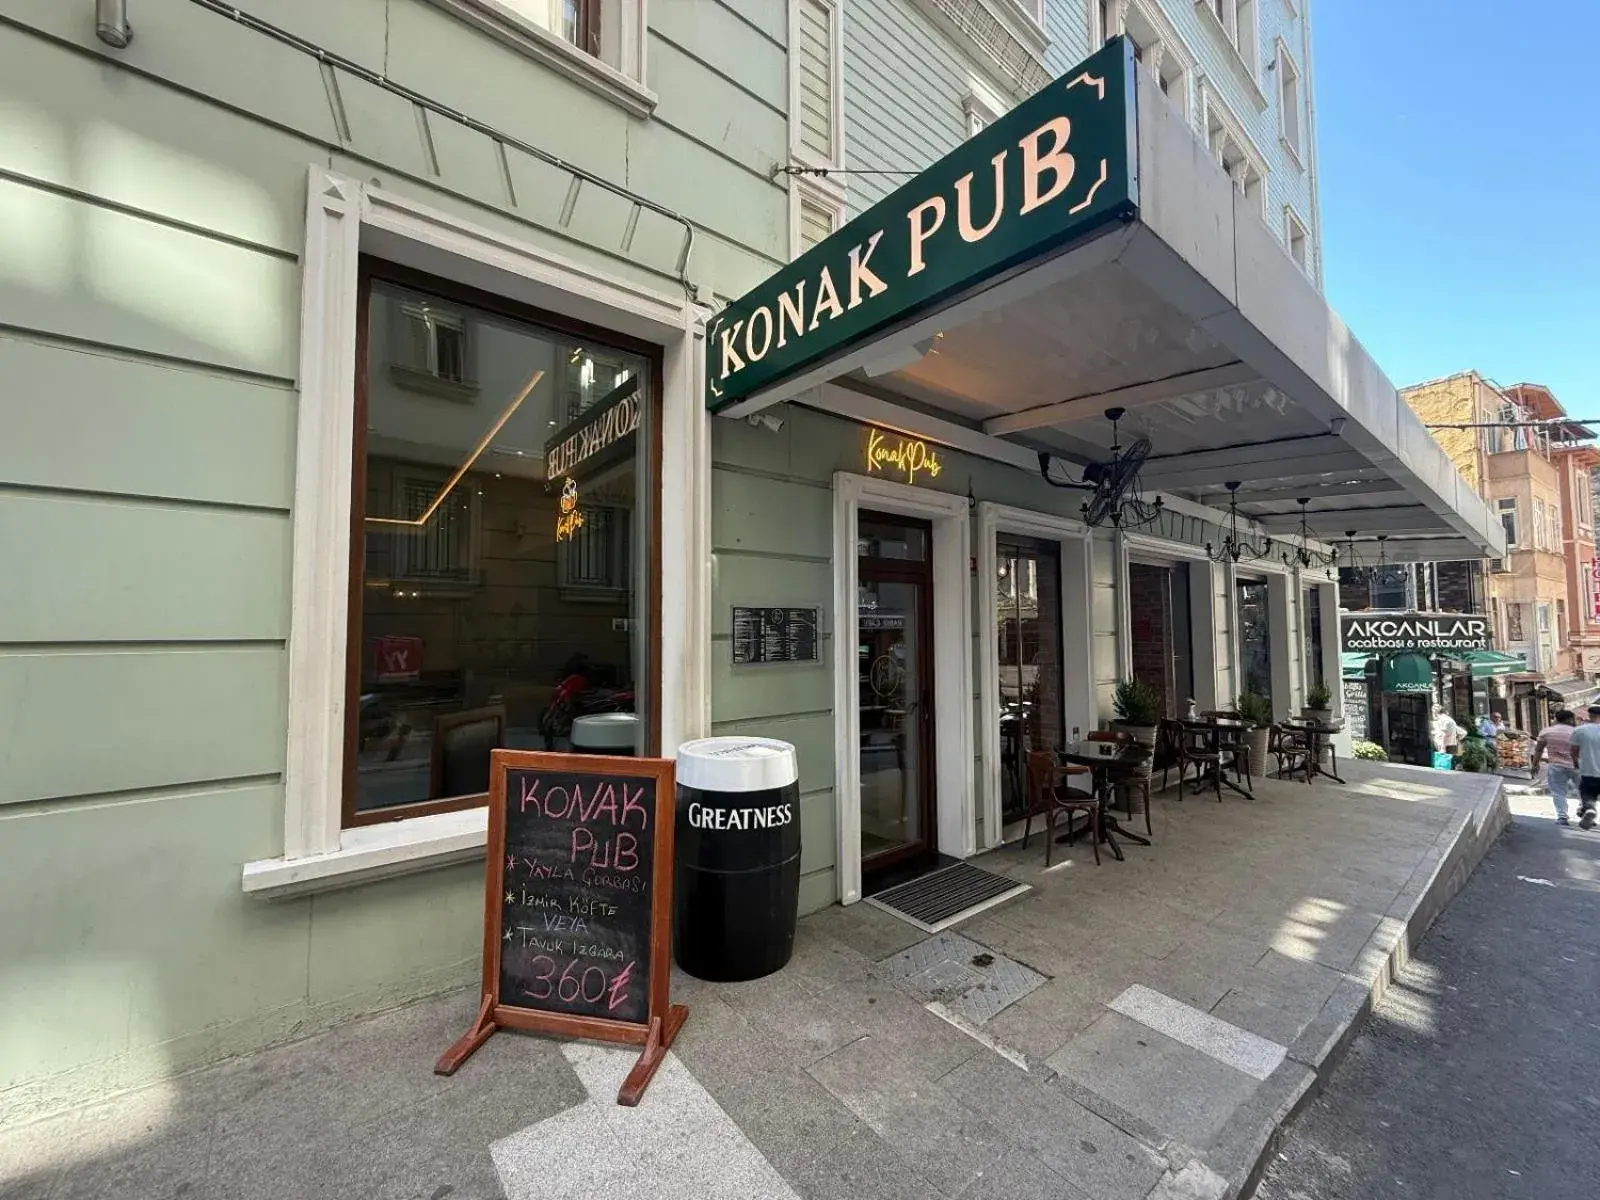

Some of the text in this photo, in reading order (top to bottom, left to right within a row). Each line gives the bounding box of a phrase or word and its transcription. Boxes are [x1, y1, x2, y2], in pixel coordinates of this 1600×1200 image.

[719, 116, 1077, 380] KONAK PUB
[867, 428, 942, 484] Konak Pub
[1346, 620, 1487, 637] AKCANLAR
[1407, 639, 1415, 648] &
[1418, 636, 1487, 649] restaurant
[520, 776, 648, 831] KONAK
[688, 802, 794, 831] GREATNESS
[570, 827, 640, 871] PUB
[523, 857, 574, 880] YAYLA
[542, 911, 590, 935] VEYA
[515, 926, 564, 956] TAVUK
